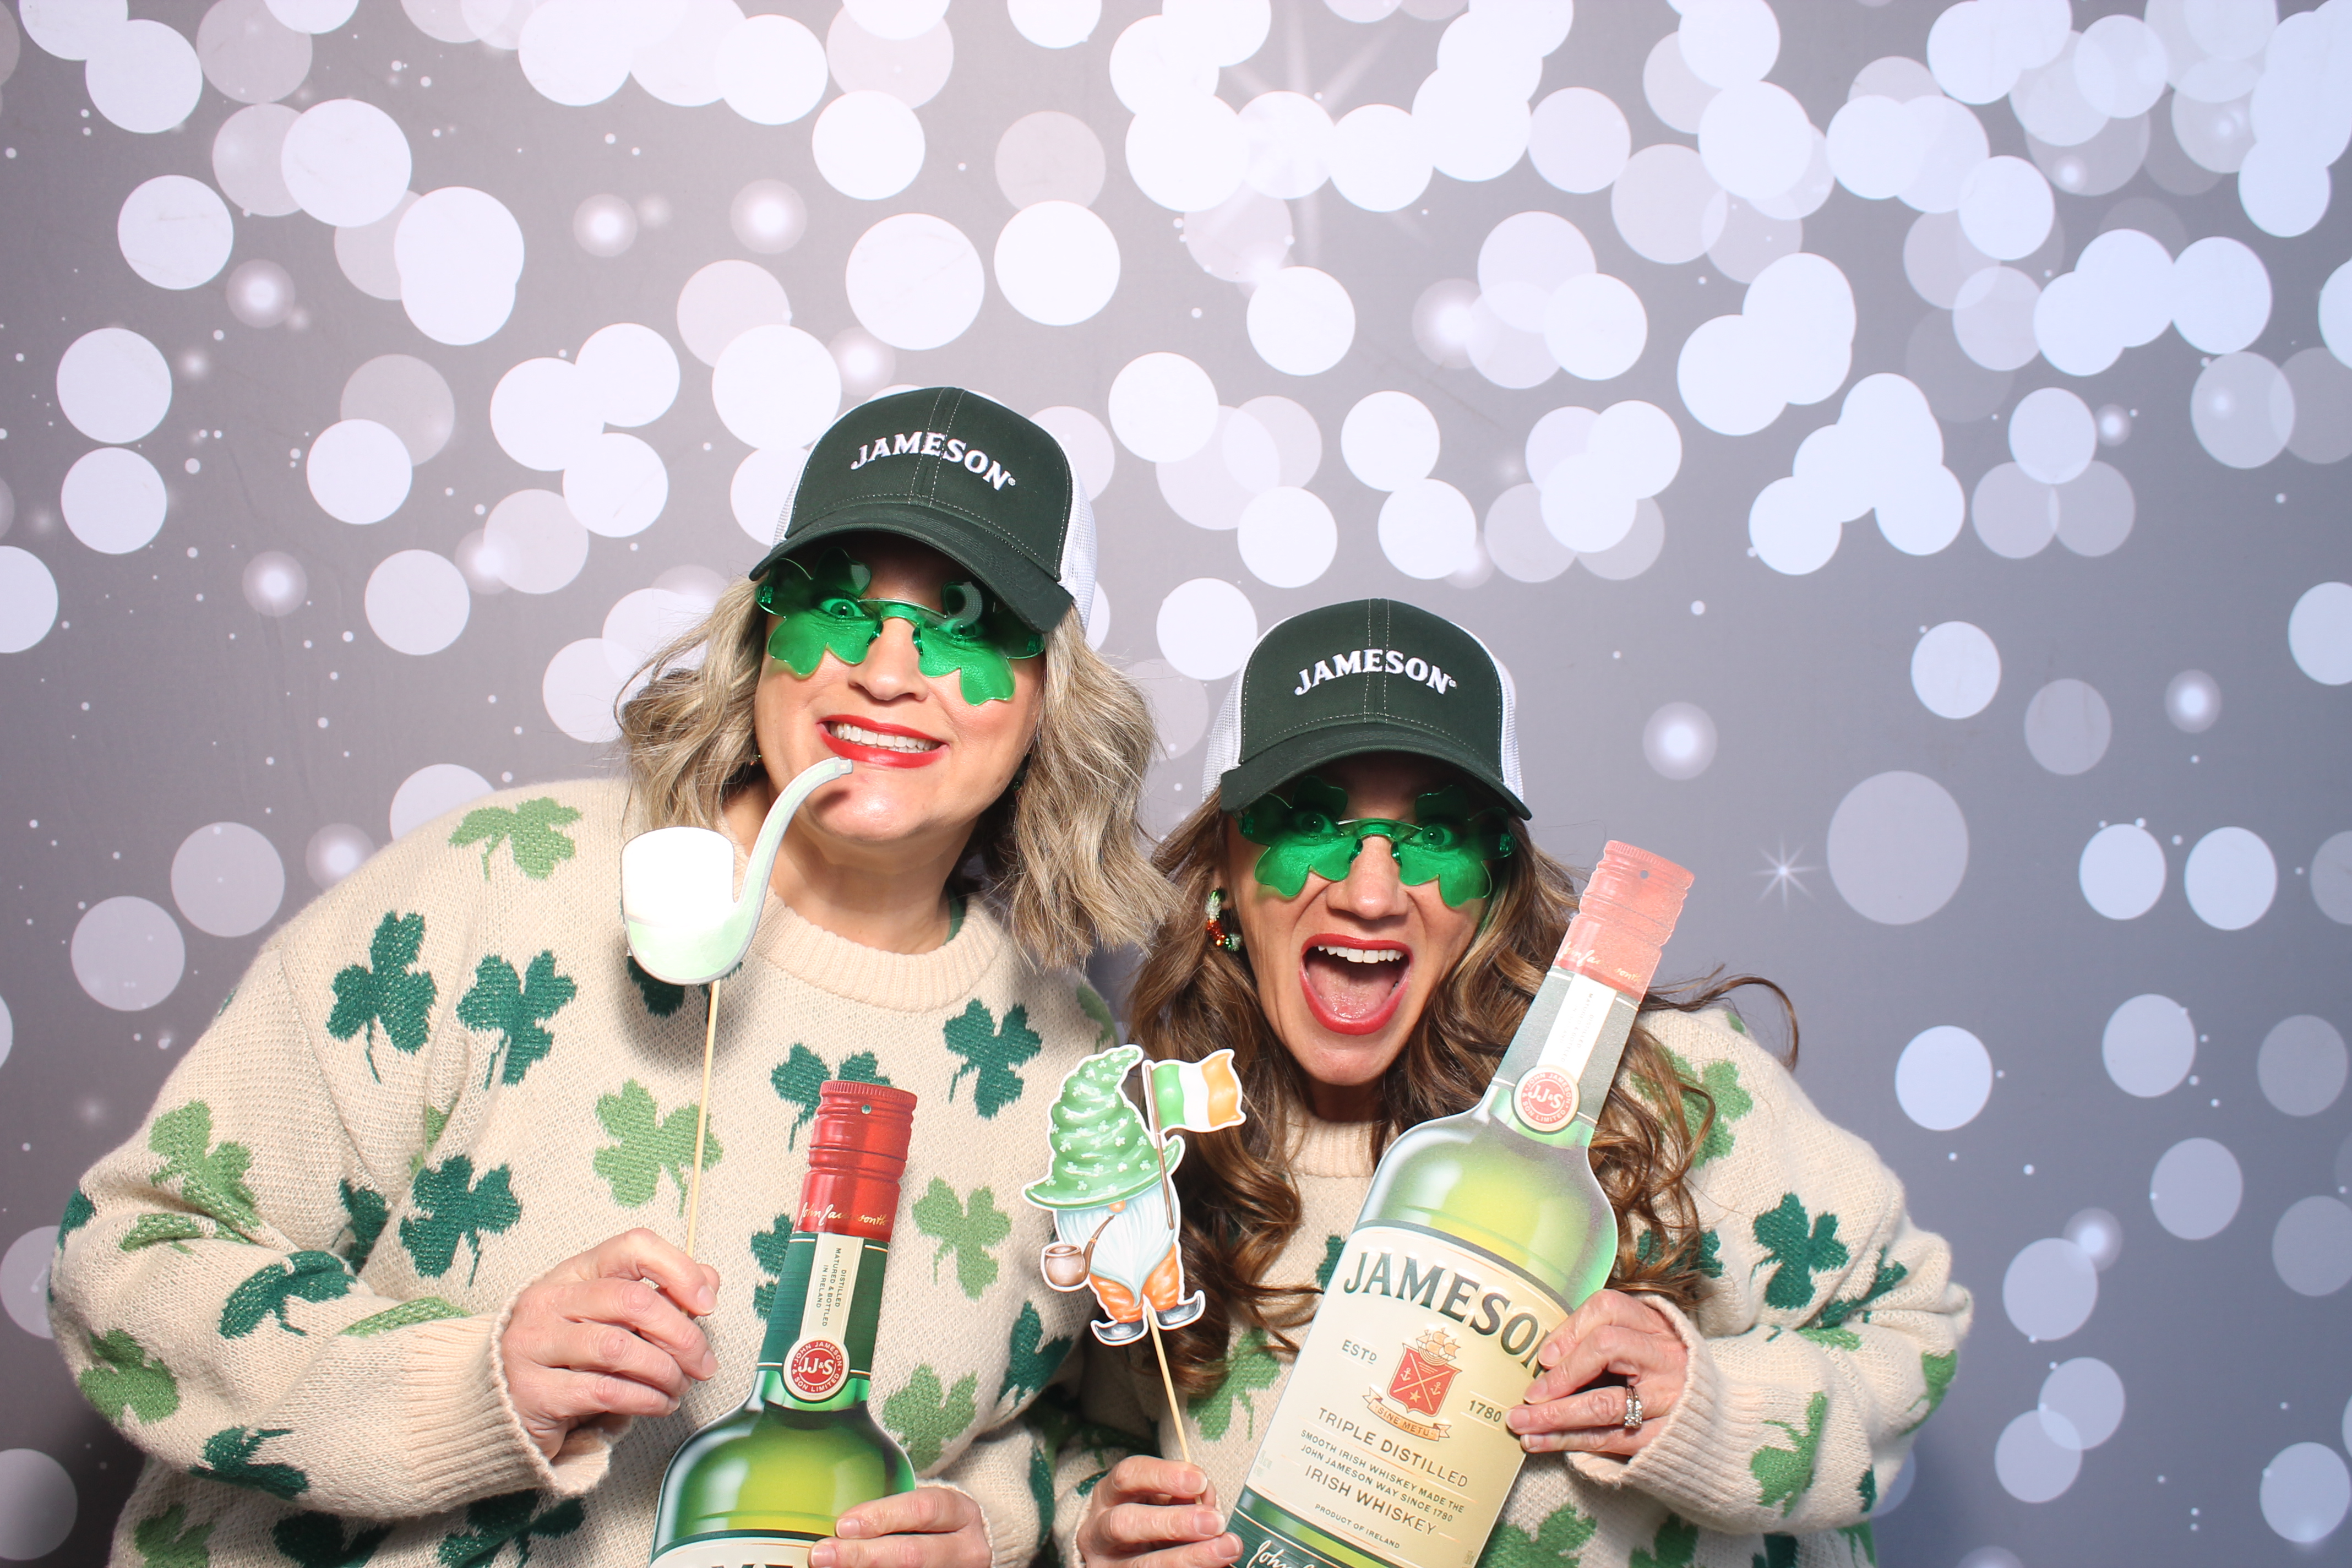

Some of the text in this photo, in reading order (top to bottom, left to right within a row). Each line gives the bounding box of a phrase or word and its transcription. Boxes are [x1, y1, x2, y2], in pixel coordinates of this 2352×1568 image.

[851, 431, 1012, 491] JAMESON
[1294, 649, 1452, 695] JAMESON
[1527, 1073, 1571, 1104] JOHN JAMESON
[1528, 1085, 1564, 1108] JJ&S
[1522, 1101, 1534, 1116] SON
[1536, 1110, 1566, 1122] LIMITED
[830, 1248, 841, 1283] MATURED
[816, 1275, 827, 1308] IRELAND
[835, 1270, 847, 1307] DISTILLED
[822, 1293, 833, 1326] BOTTLED
[794, 1342, 842, 1366] JOHN JAMESON
[798, 1357, 834, 1375] JJ&S
[794, 1376, 808, 1390] SON
[811, 1373, 839, 1392] LIMITED
[1378, 1407, 1430, 1437] SINE METU
[1468, 1400, 1502, 1423] 1780
[1319, 1407, 1468, 1487] TRIPLE DISTILLED
[1301, 1429, 1464, 1513] SMOOTH IRISH WHISKEY MADE THE
[1301, 1444, 1453, 1522] JOHN JAMESON WAY SINCE 1780
[1305, 1464, 1436, 1535] IRISH WHISKEY
[1315, 1504, 1400, 1549] PRODUCT OF IRELAND
